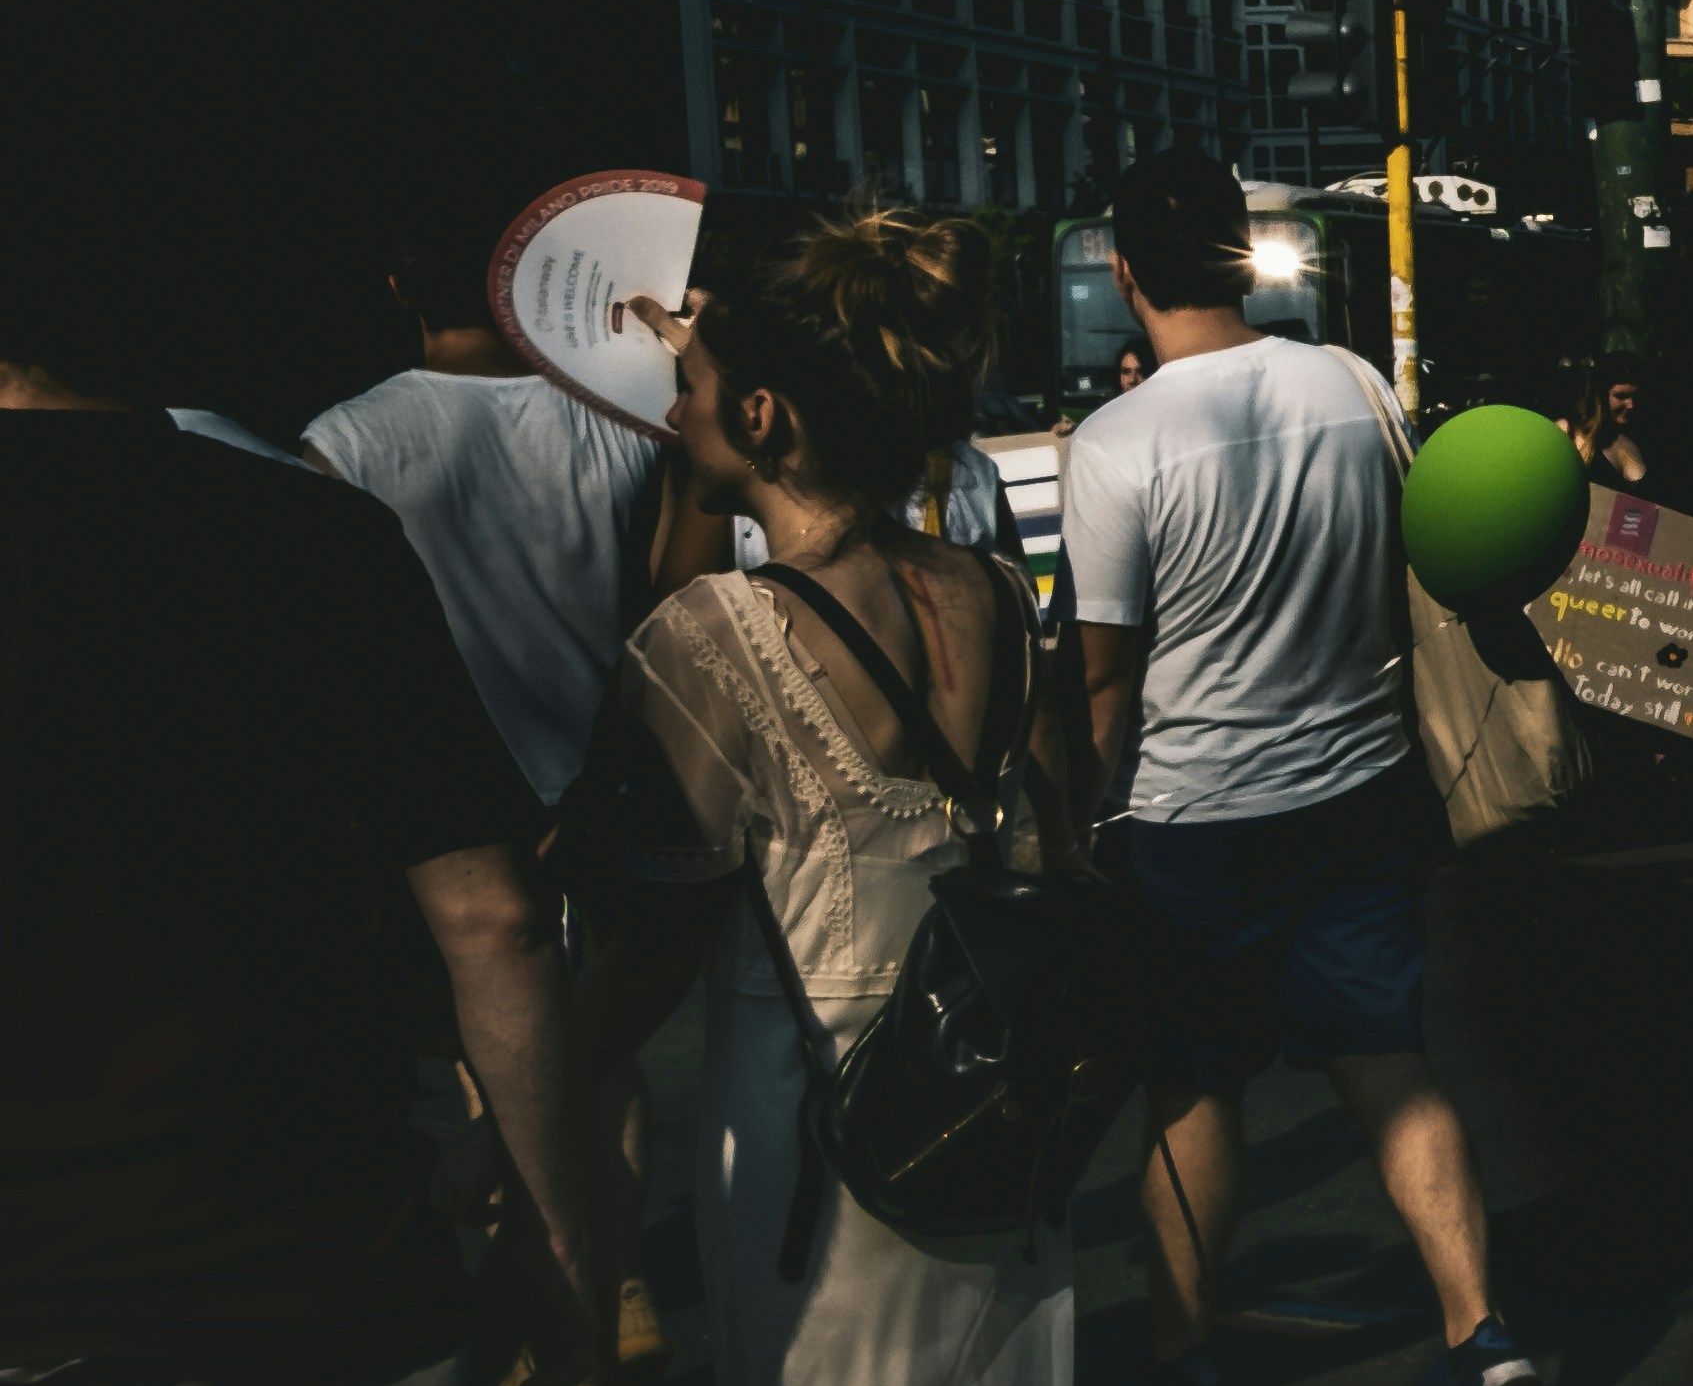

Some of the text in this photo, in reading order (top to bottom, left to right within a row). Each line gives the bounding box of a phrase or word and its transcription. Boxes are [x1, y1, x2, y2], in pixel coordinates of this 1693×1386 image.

[514, 192, 576, 241] MILANO
[578, 179, 632, 198] PRIDE
[563, 249, 585, 311] WELCOME
[1578, 564, 1615, 590] let's
[1619, 578, 1642, 597] all
[1644, 588, 1680, 608] call
[1550, 591, 1627, 622] queer
[1628, 606, 1651, 630] to
[1549, 637, 1584, 671] llo
[1596, 661, 1652, 683] can't
[1574, 673, 1634, 716] Today
